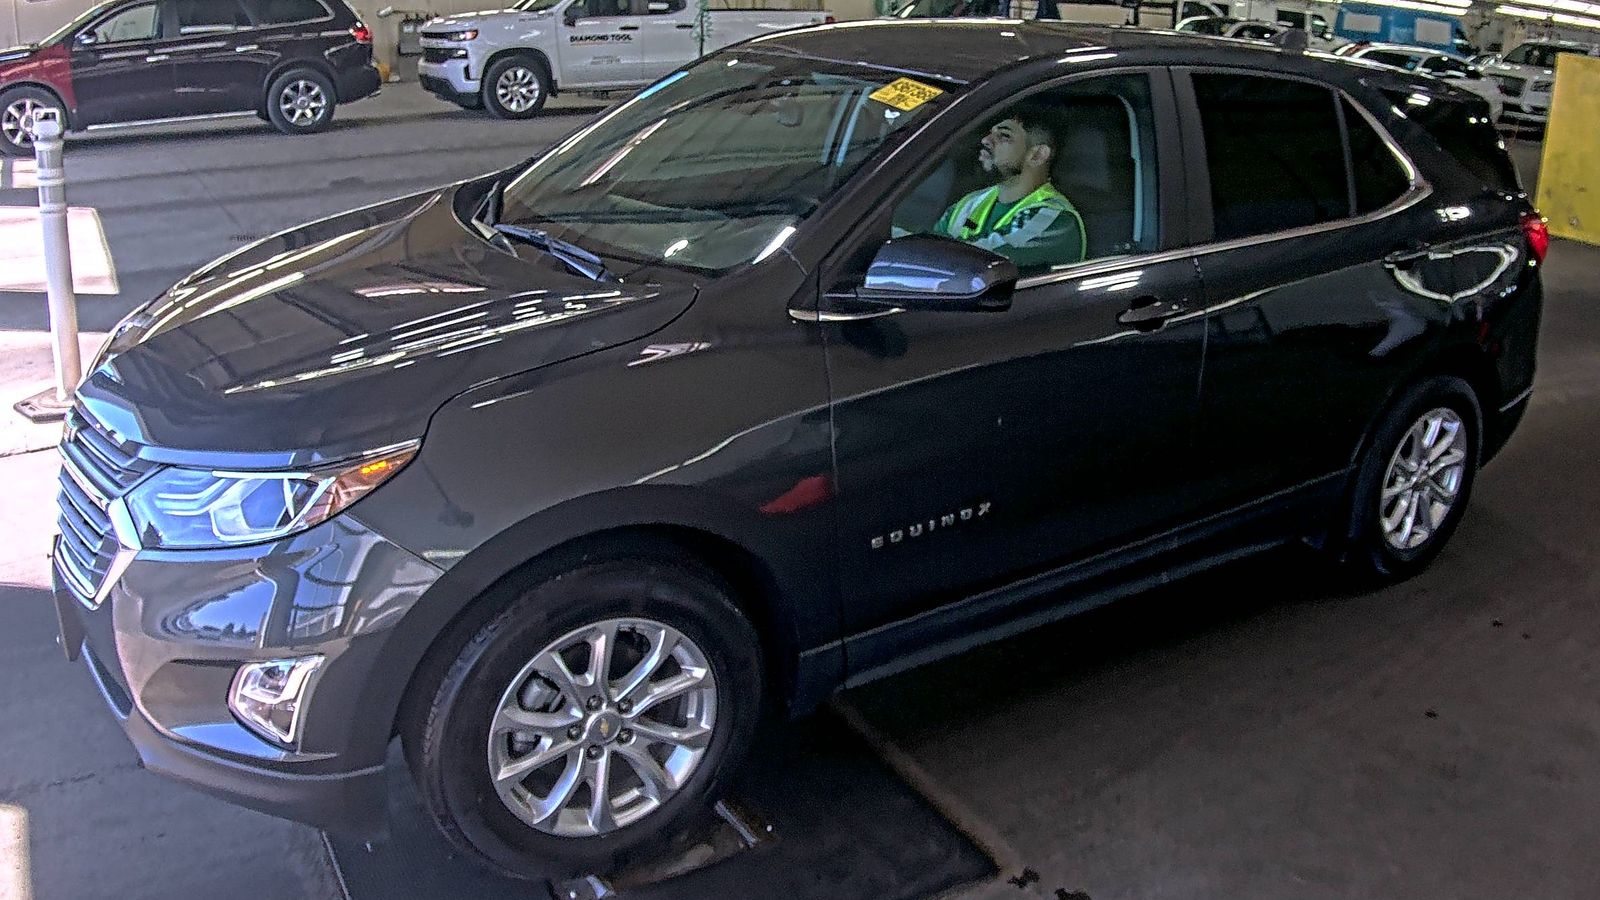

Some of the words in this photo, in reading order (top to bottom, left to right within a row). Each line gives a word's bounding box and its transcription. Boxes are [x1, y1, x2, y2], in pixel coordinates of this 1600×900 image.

[569, 34, 609, 43] DIAMOND
[610, 33, 633, 41] TOOL
[871, 501, 991, 549] EQUINOX
